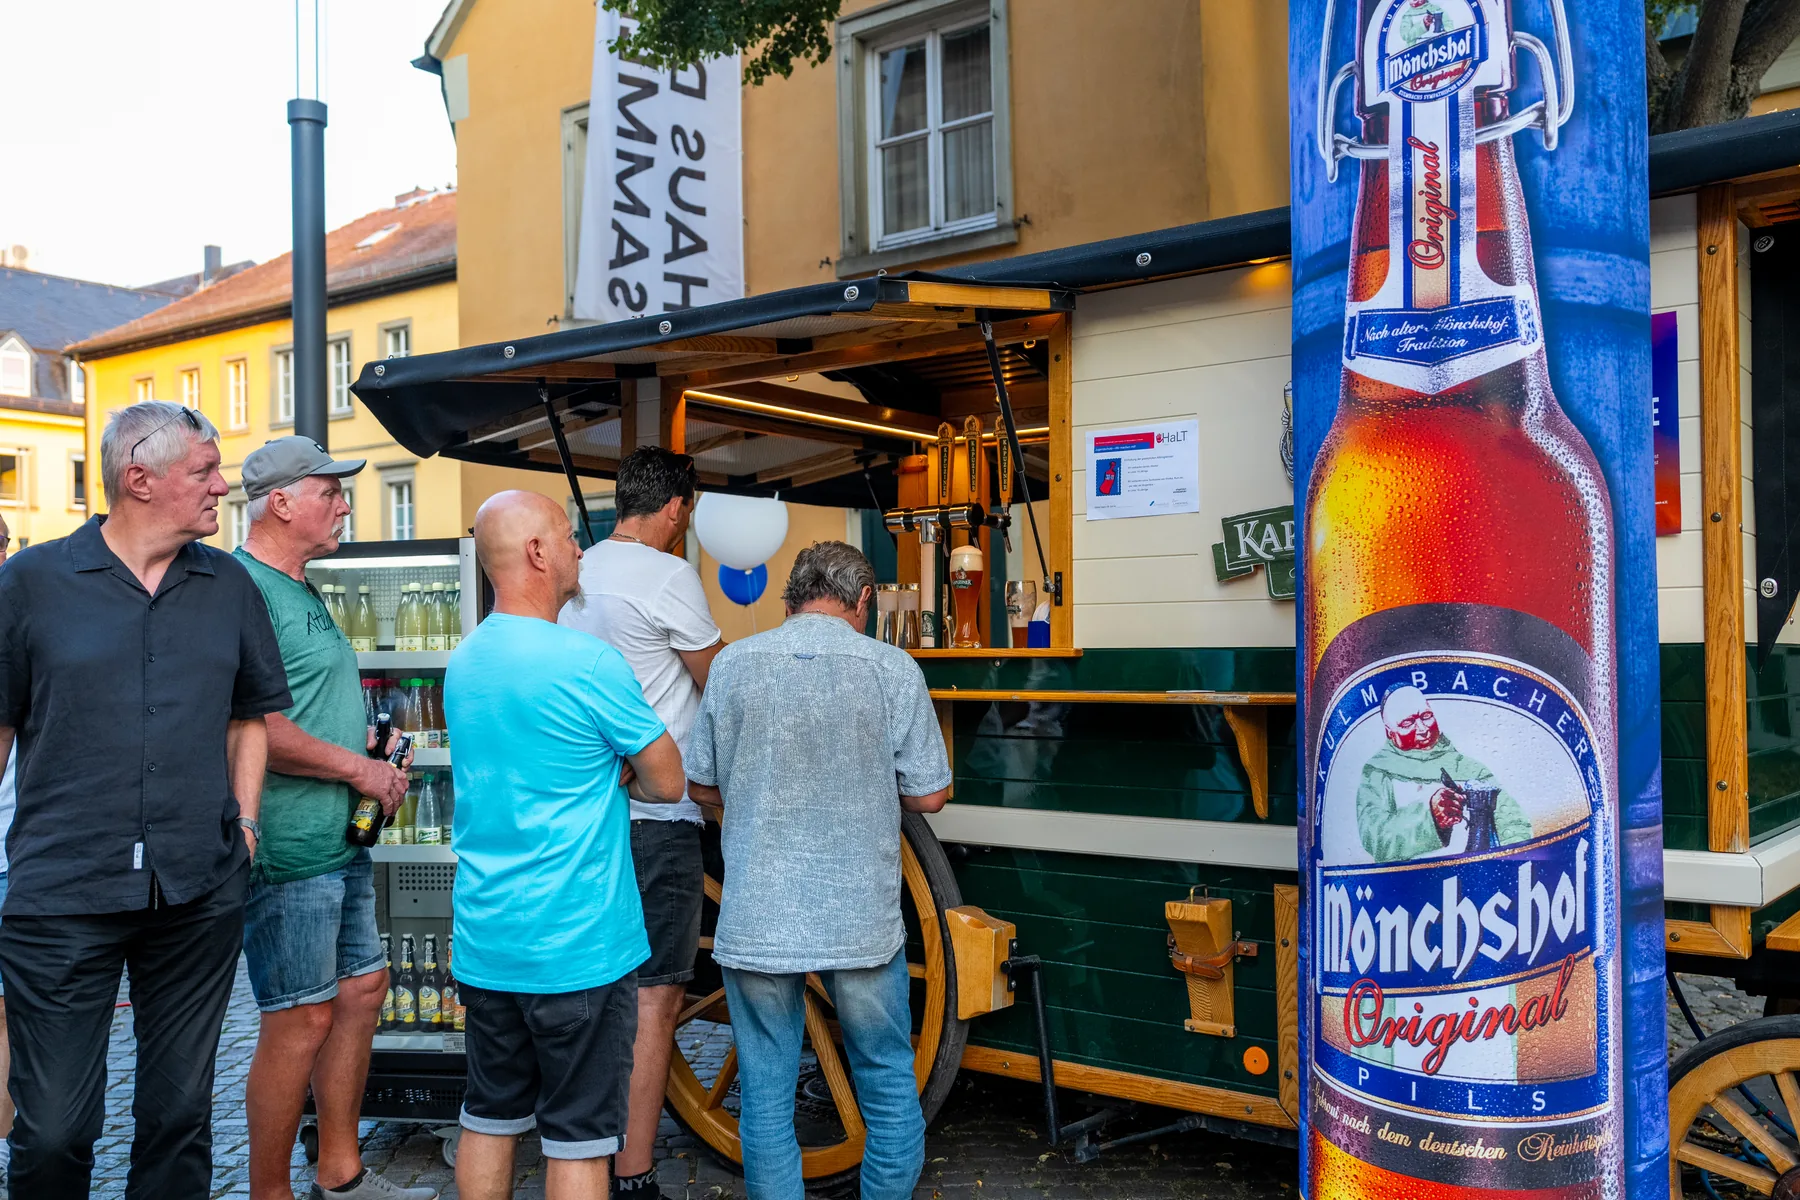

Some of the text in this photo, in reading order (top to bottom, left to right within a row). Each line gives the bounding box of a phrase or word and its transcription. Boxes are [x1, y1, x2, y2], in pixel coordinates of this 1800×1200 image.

[1389, 30, 1472, 84] Mönchshof
[1410, 59, 1468, 91] Original
[1407, 136, 1457, 270] Original
[1360, 324, 1390, 344] Nach
[1391, 320, 1424, 337] alter
[1396, 336, 1469, 353] Tradition
[1651, 396, 1660, 427] E
[1162, 430, 1188, 443] HaLT
[1318, 669, 1589, 783] KULMBACHER
[1323, 838, 1590, 980] Mönchshof
[1343, 953, 1576, 1075] Original
[1358, 1067, 1547, 1112] PILS
[1342, 1113, 1372, 1135] nach
[1377, 1121, 1412, 1147] dem
[1419, 1131, 1509, 1161] deutschen
